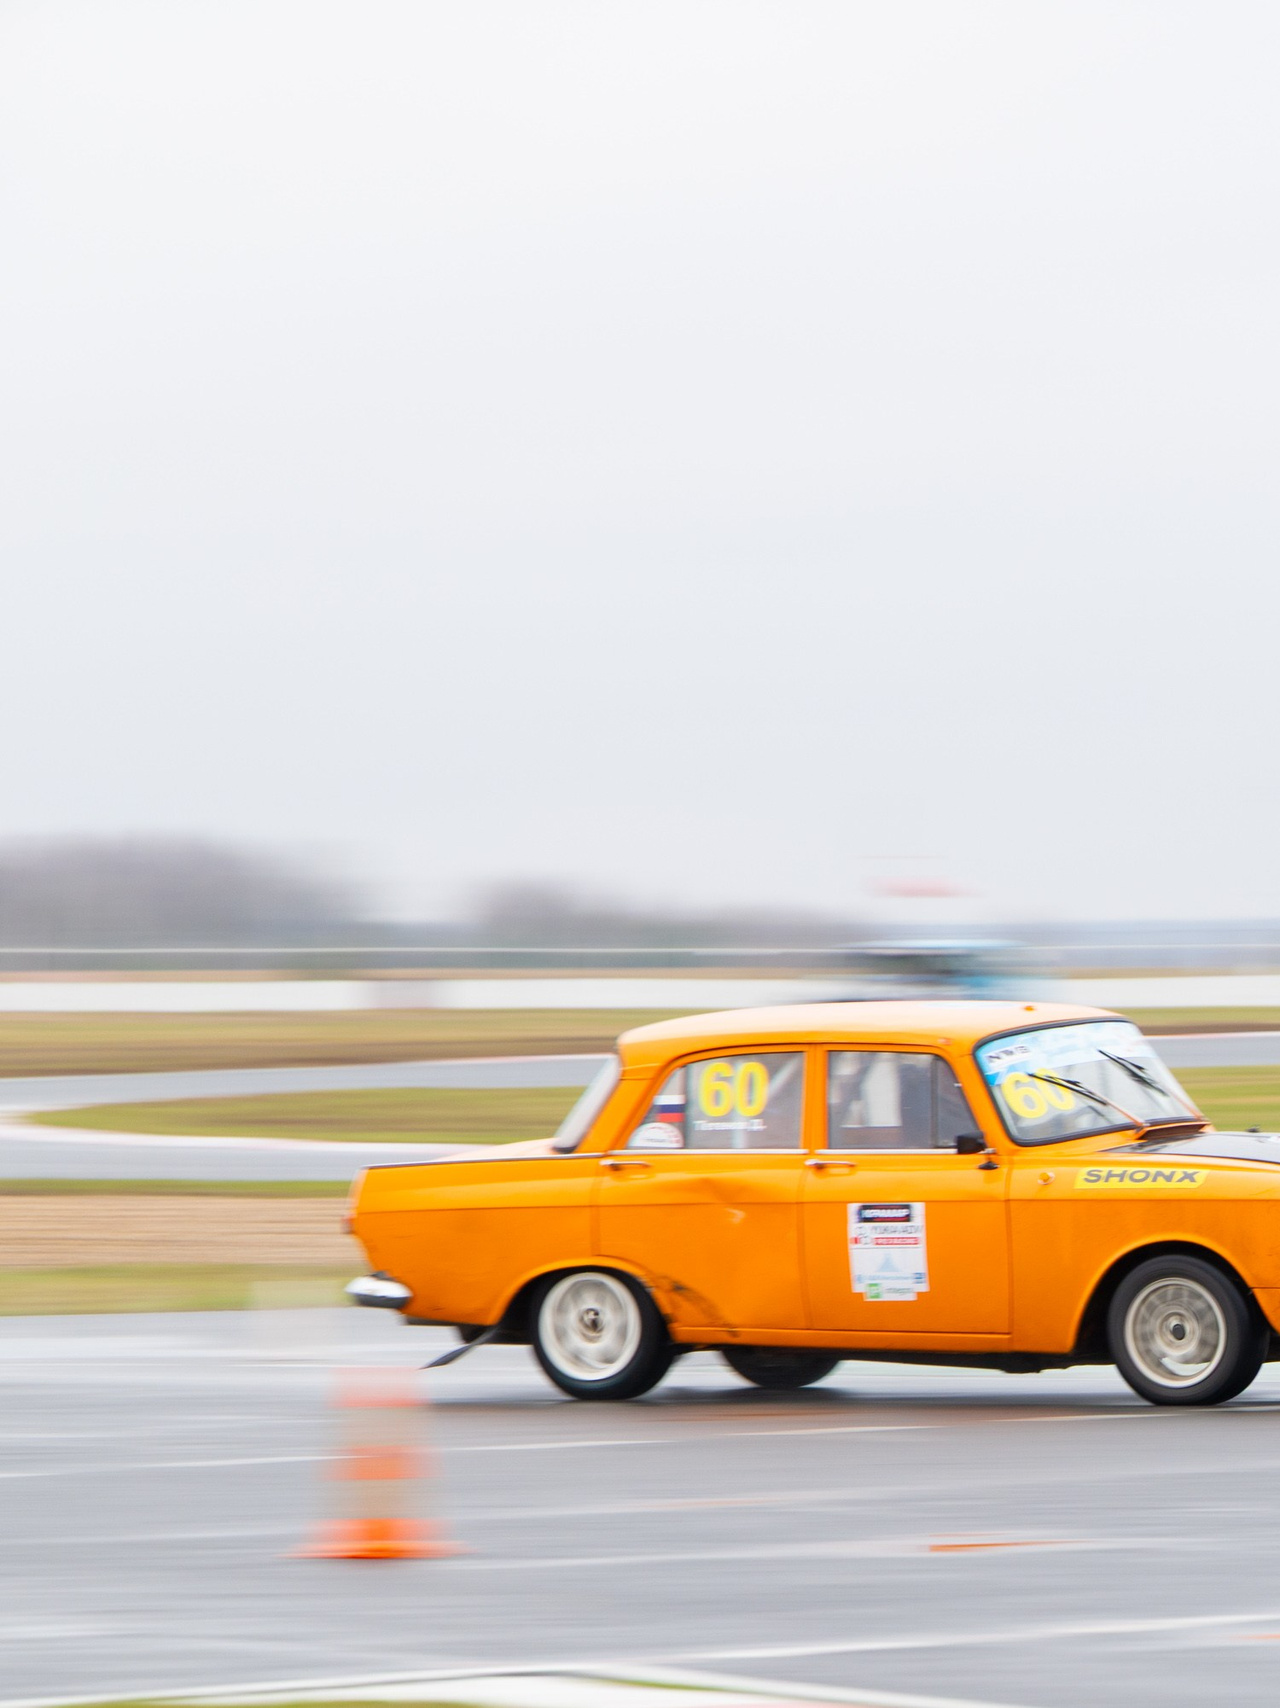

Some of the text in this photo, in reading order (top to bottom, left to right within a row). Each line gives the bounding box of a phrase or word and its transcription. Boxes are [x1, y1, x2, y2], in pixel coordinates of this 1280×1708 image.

[699, 1061, 770, 1117] 60
[1001, 1068, 1075, 1118] 60
[1083, 1169, 1200, 1184] SHONX
